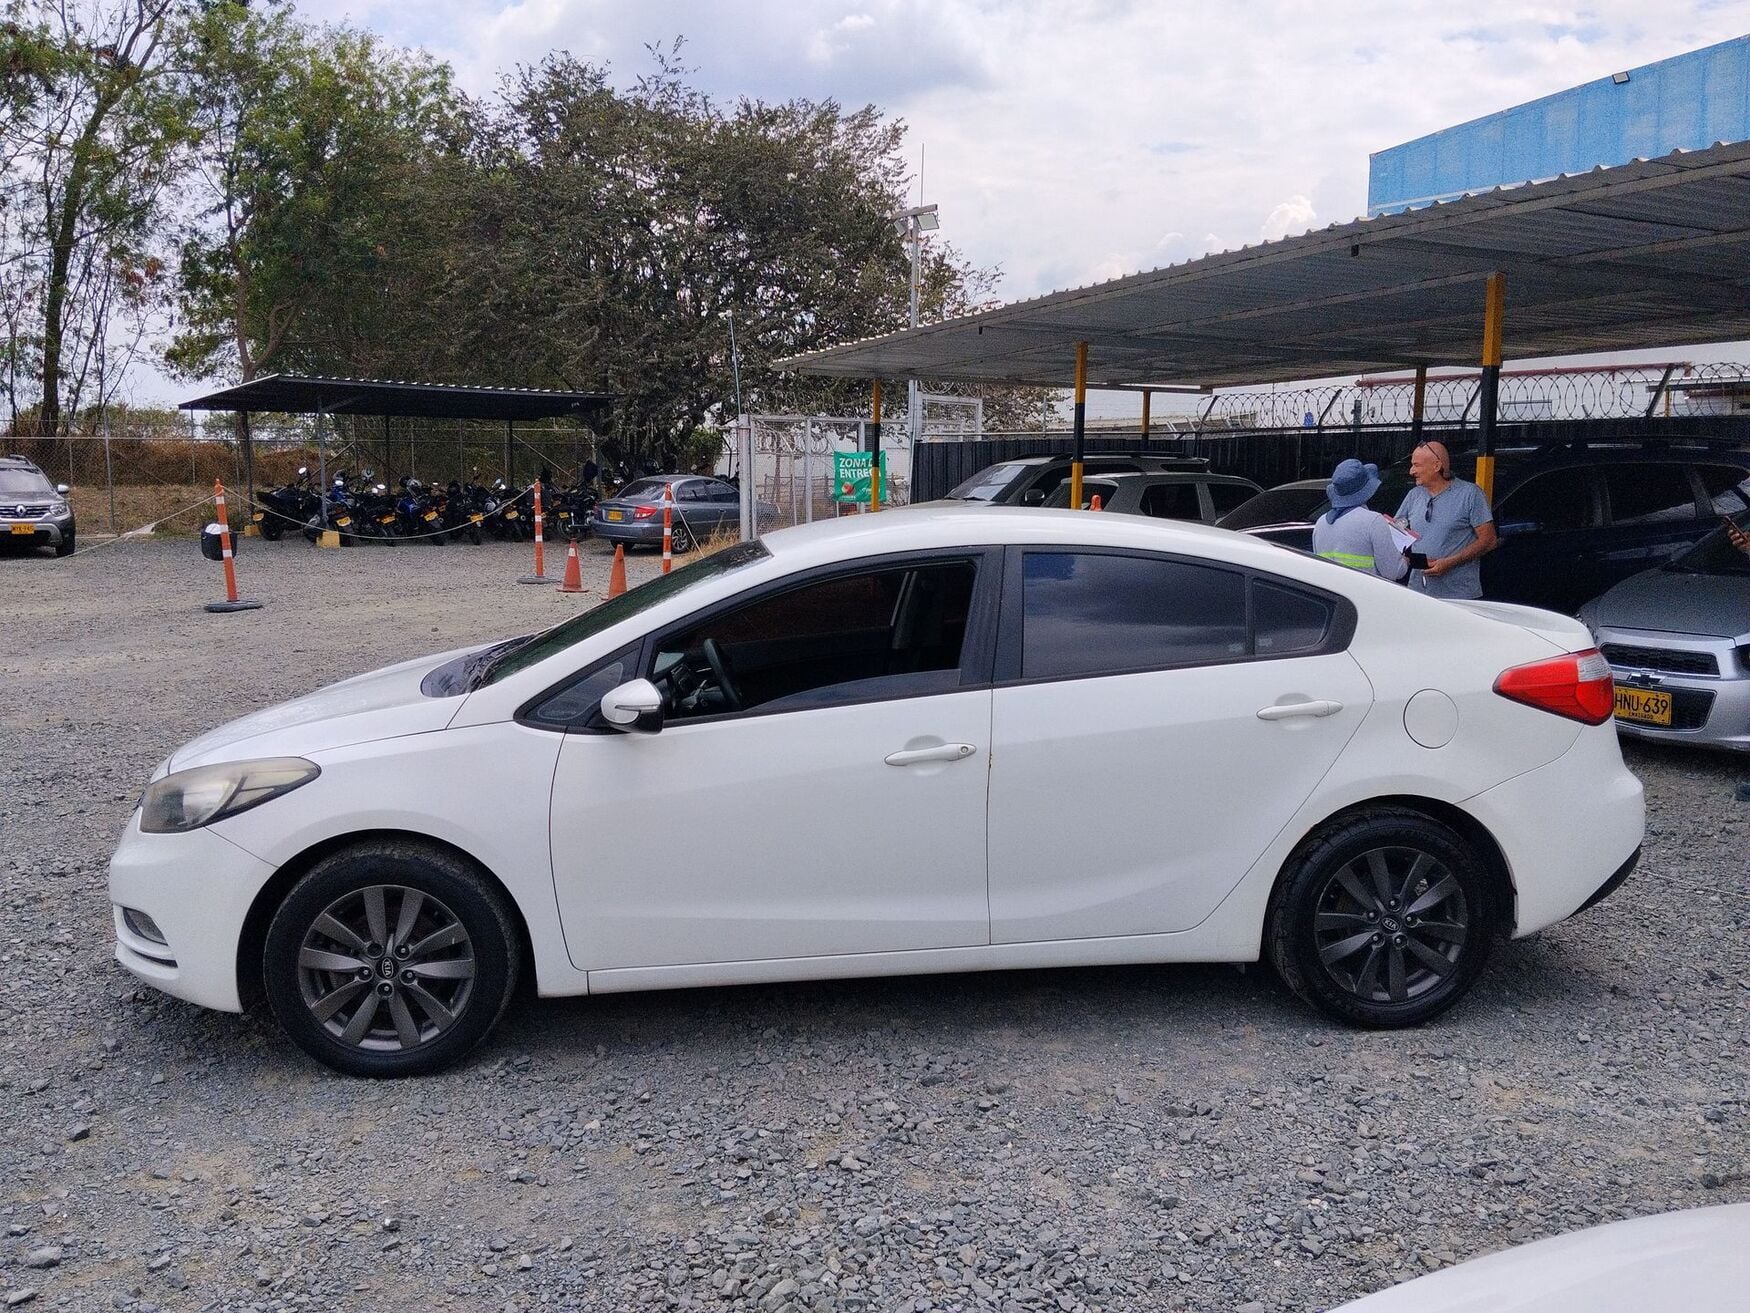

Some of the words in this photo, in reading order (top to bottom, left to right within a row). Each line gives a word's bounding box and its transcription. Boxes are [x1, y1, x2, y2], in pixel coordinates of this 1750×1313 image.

[840, 458, 867, 468] ZONA
[840, 468, 881, 478] ENTRE
[1614, 693, 1669, 715] HNU-639
[1384, 919, 1397, 930] KIA
[383, 960, 392, 976] KIA
